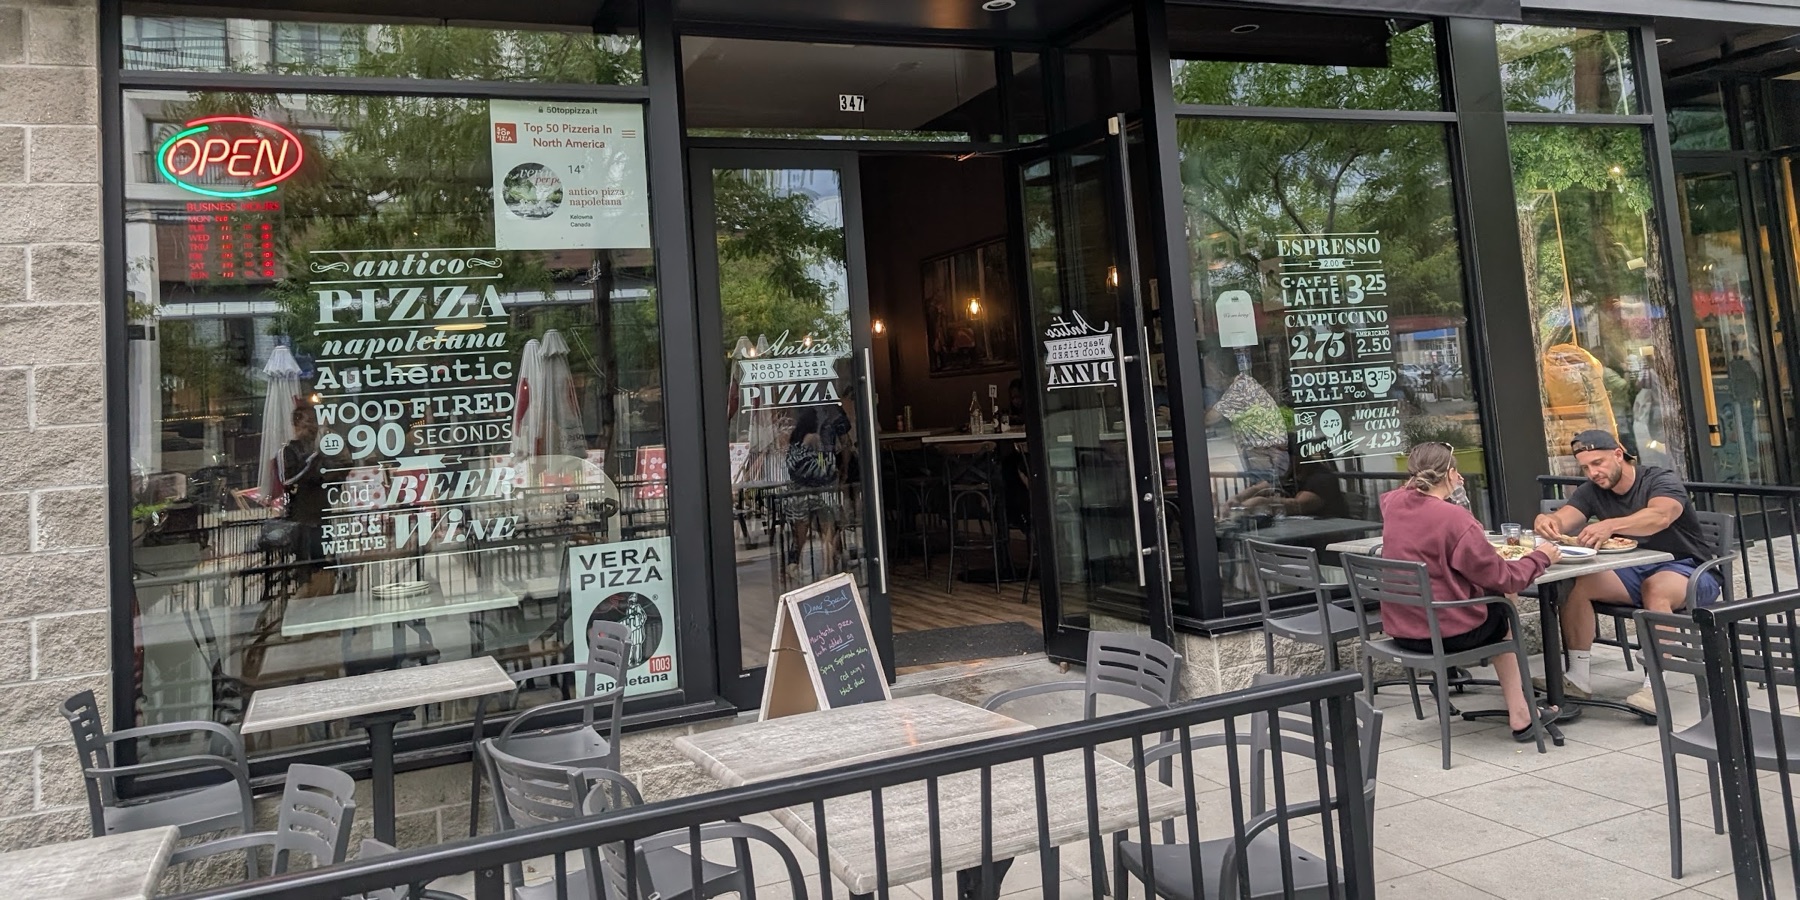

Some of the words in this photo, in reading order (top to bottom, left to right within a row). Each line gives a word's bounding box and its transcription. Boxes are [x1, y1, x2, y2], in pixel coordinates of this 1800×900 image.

[546, 106, 598, 115] 50toppizza.it
[841, 96, 863, 110] 347
[524, 122, 542, 134] Top
[546, 124, 558, 132] 50
[562, 124, 600, 134] Pizzeria
[603, 125, 612, 134] In
[533, 138, 562, 148] North
[566, 138, 605, 148] America
[167, 139, 289, 176] OPEN
[568, 188, 598, 196] antico
[601, 188, 625, 197] pizza
[186, 202, 236, 212] BUSINESS
[570, 198, 622, 208] napoletana
[188, 215, 210, 223] MON
[188, 234, 210, 242] WED
[1276, 238, 1380, 256] ESPRESSO
[353, 252, 464, 277] antico
[314, 285, 510, 324] PIZZA
[1282, 288, 1340, 306] LATTE
[1284, 310, 1388, 328] CAPPUCCINO
[742, 329, 833, 357] Antico
[1356, 330, 1390, 338] AMERICANO
[321, 330, 506, 360] napoletana
[1289, 332, 1346, 362] 2.75
[1357, 337, 1392, 353] 2.50
[314, 357, 513, 390] Authentic
[750, 371, 784, 380] WOOD
[789, 368, 828, 378] FIRED
[751, 360, 826, 372] Neapolitan
[1290, 369, 1364, 388] DOUBLE
[741, 381, 840, 408] PIZZA
[1292, 387, 1343, 403] TALL
[1354, 390, 1366, 398] GO
[1323, 420, 1340, 429] 2.75
[1364, 418, 1400, 431] CCINO
[325, 437, 339, 450] in
[348, 422, 406, 460] 90
[414, 423, 512, 446] SECONDS
[1296, 426, 1317, 444] Hot
[1300, 430, 1353, 458] Chocolate
[1366, 431, 1401, 449] 4.25
[327, 484, 370, 505] Cold
[385, 467, 516, 506] BEER
[321, 522, 364, 538] RED
[321, 536, 386, 556] WHITE
[579, 546, 661, 570] VERA
[580, 566, 663, 590] PIZZA
[651, 656, 670, 672] 1003
[596, 673, 668, 692] apletana
[840, 670, 850, 682] red
